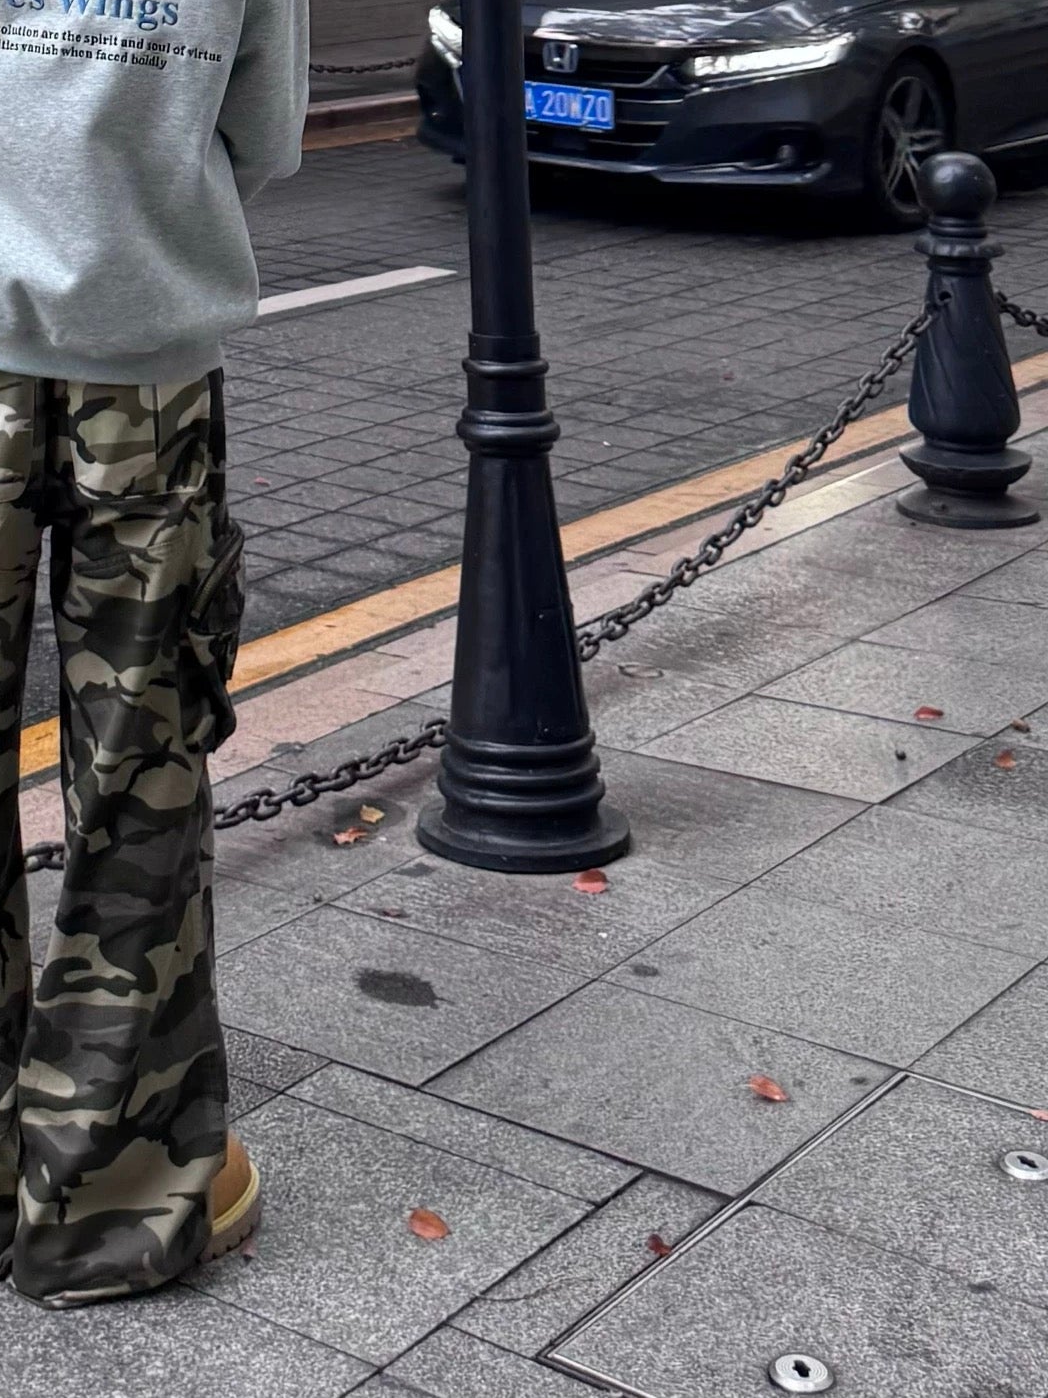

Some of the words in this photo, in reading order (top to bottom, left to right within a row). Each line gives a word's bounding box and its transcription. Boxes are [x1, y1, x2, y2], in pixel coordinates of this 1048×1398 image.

[21, 42, 58, 56] vanish
[60, 46, 93, 59] when
[95, 49, 128, 63] faced
[131, 53, 168, 70] boldly
[40, 31, 58, 40] are
[61, 30, 81, 43] the
[83, 33, 117, 47] spirit
[120, 37, 144, 50] and
[146, 41, 170, 54] soul
[172, 45, 187, 56] of
[187, 47, 222, 63] virtue
